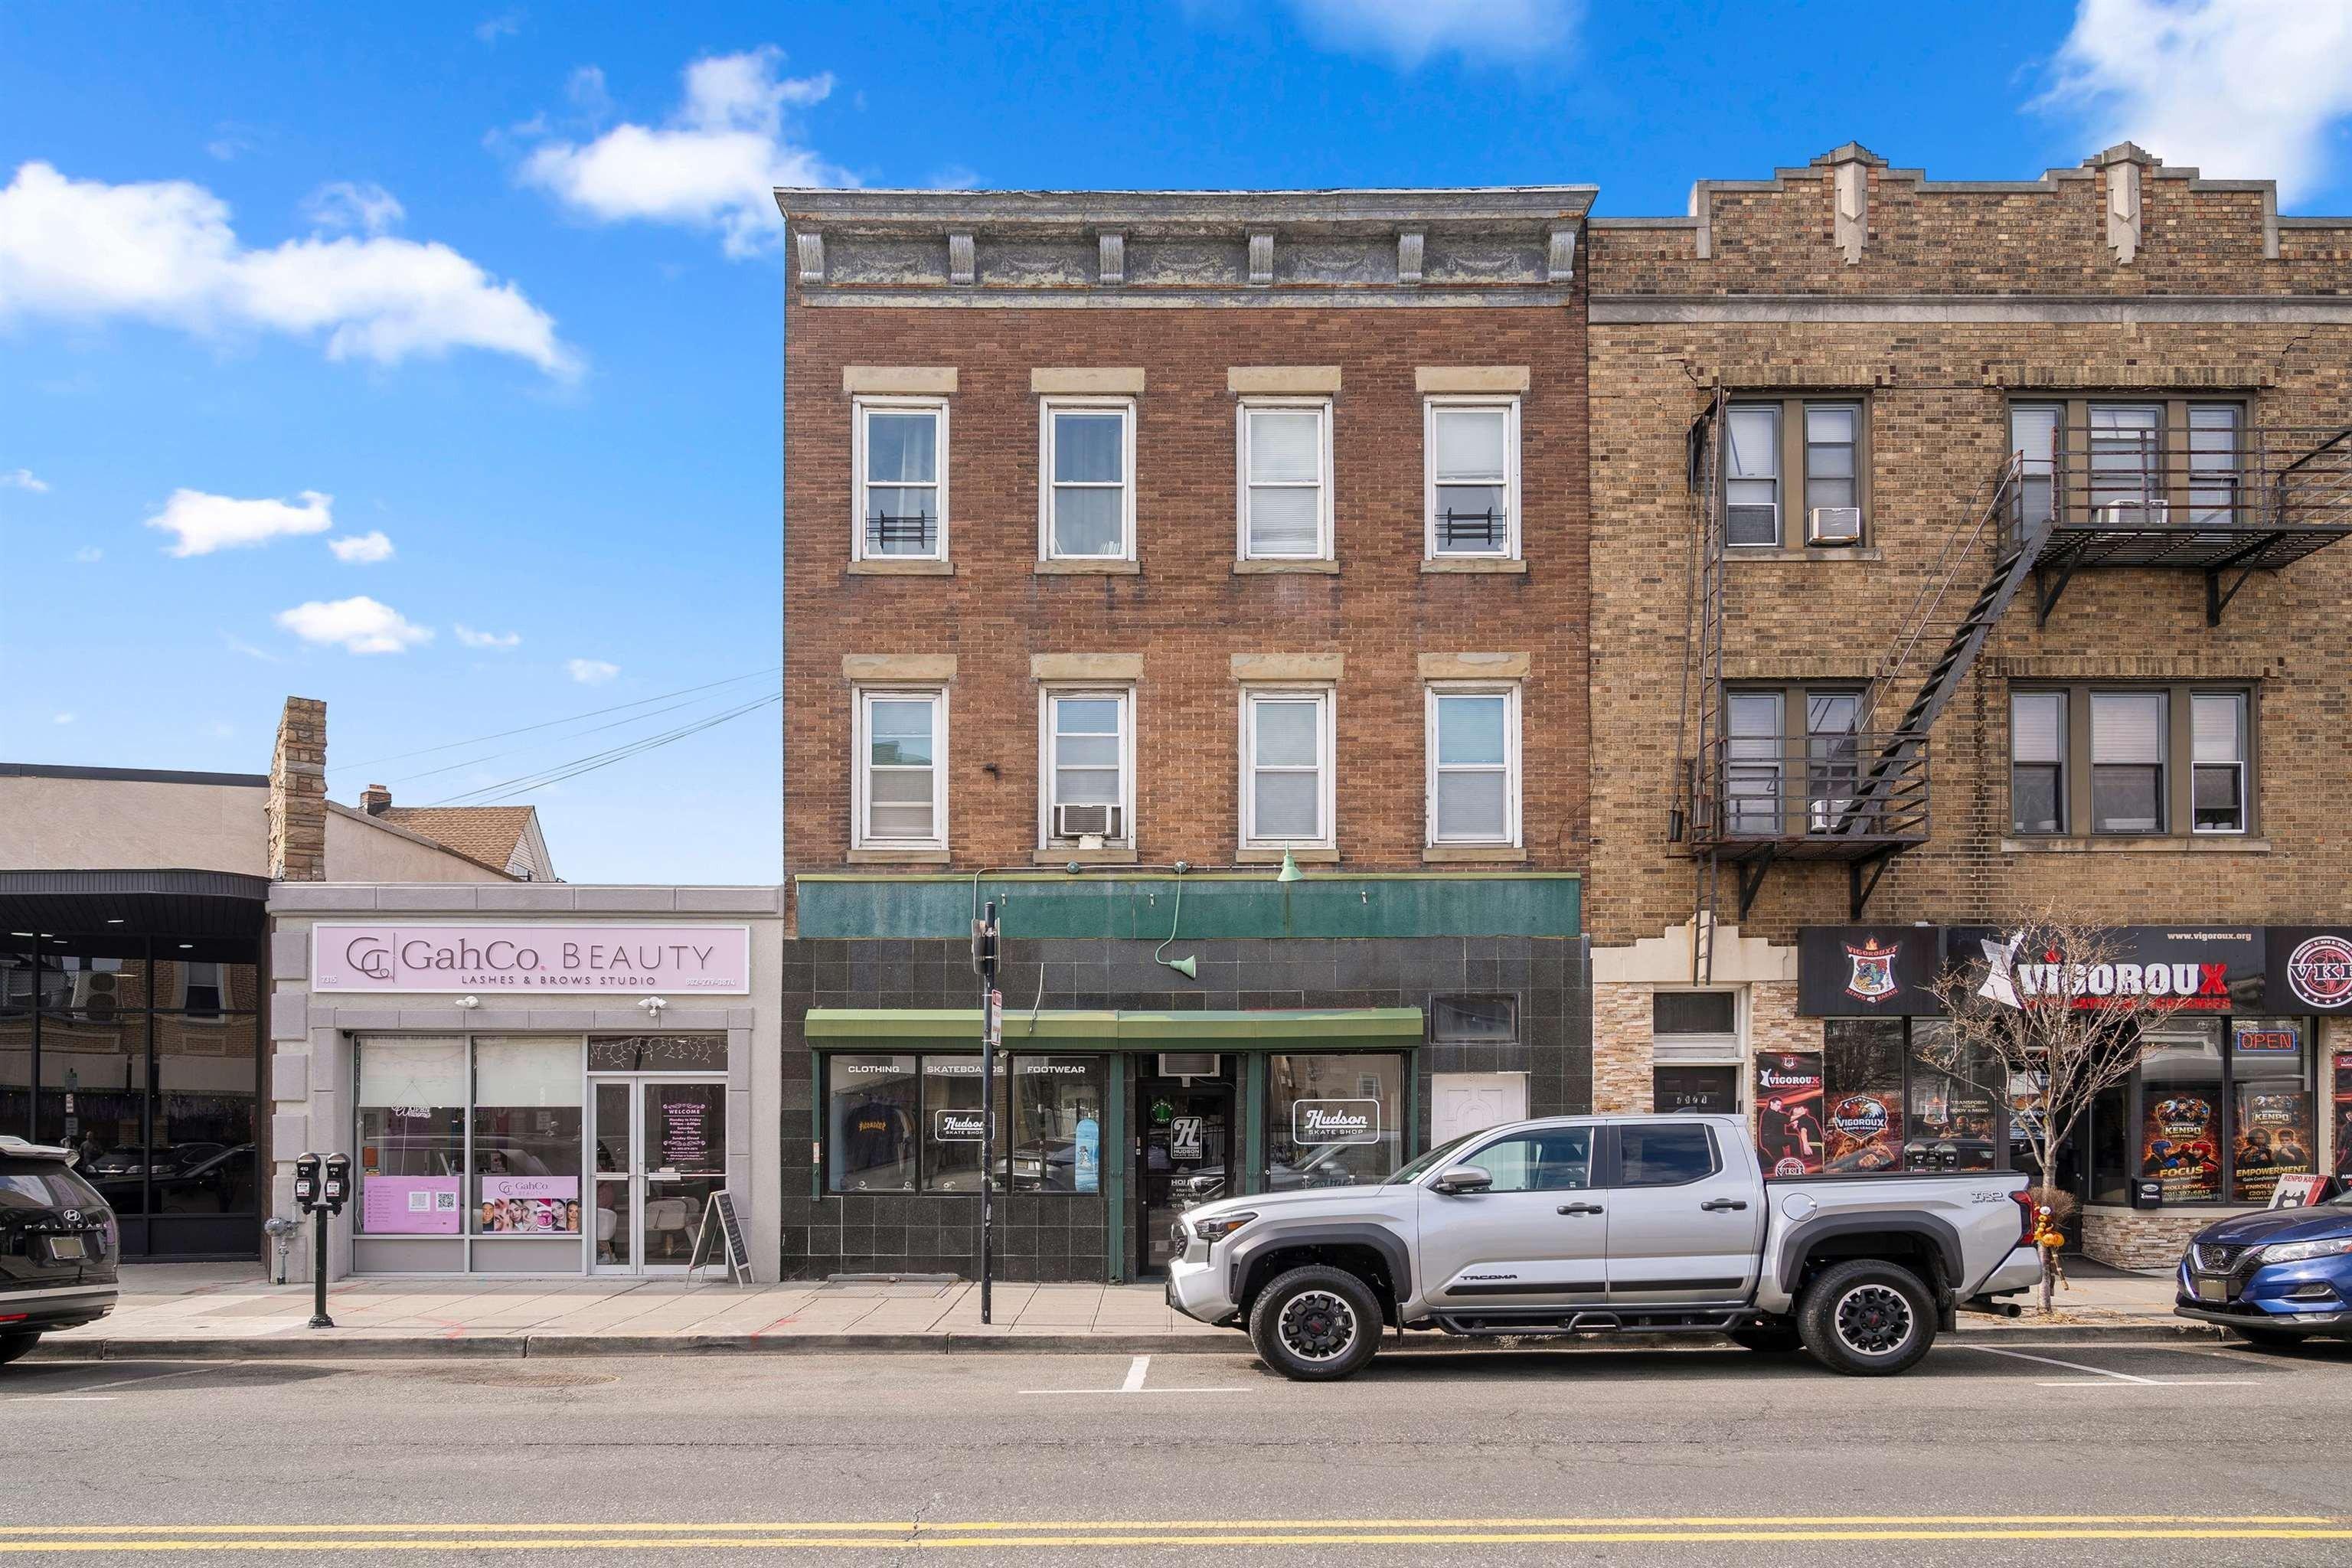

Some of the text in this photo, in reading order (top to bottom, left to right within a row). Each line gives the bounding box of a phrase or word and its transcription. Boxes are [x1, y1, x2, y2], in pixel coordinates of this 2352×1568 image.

[2167, 932, 2252, 942] www.vigoroux.org
[401, 938, 714, 970] GahCo. BEAUTY
[462, 975, 656, 985] LASHES & BROWS STUDIO
[2242, 1034, 2292, 1048] OPEN
[1305, 1109, 1367, 1129] Hudson
[2254, 1113, 2289, 1122] KENPO
[2159, 1165, 2203, 1178] FOCUS
[2236, 1165, 2308, 1177] EMPOWERMENT
[1971, 1191, 2003, 1200] TRD
